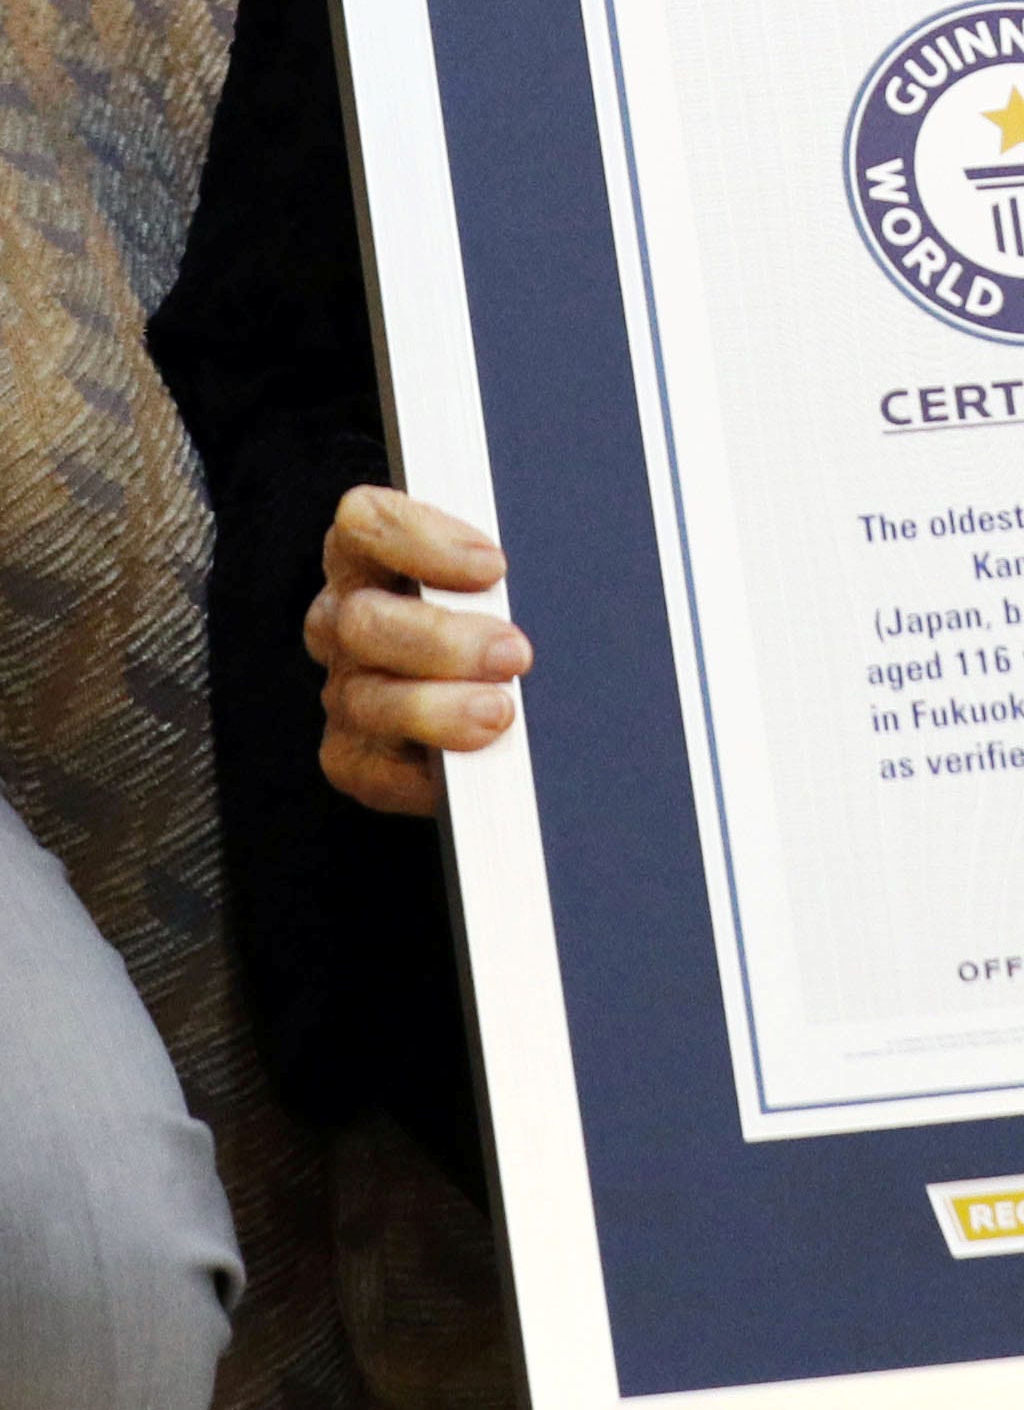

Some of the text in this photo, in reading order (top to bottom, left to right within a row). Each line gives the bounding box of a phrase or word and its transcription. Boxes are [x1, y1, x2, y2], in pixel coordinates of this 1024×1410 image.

[865, 157, 1004, 317] WORLD
[857, 513, 918, 544] The
[873, 606, 992, 643] (Japan,
[867, 649, 944, 693] aged
[955, 645, 1012, 677] 116
[870, 704, 901, 733] in
[879, 757, 916, 781] as
